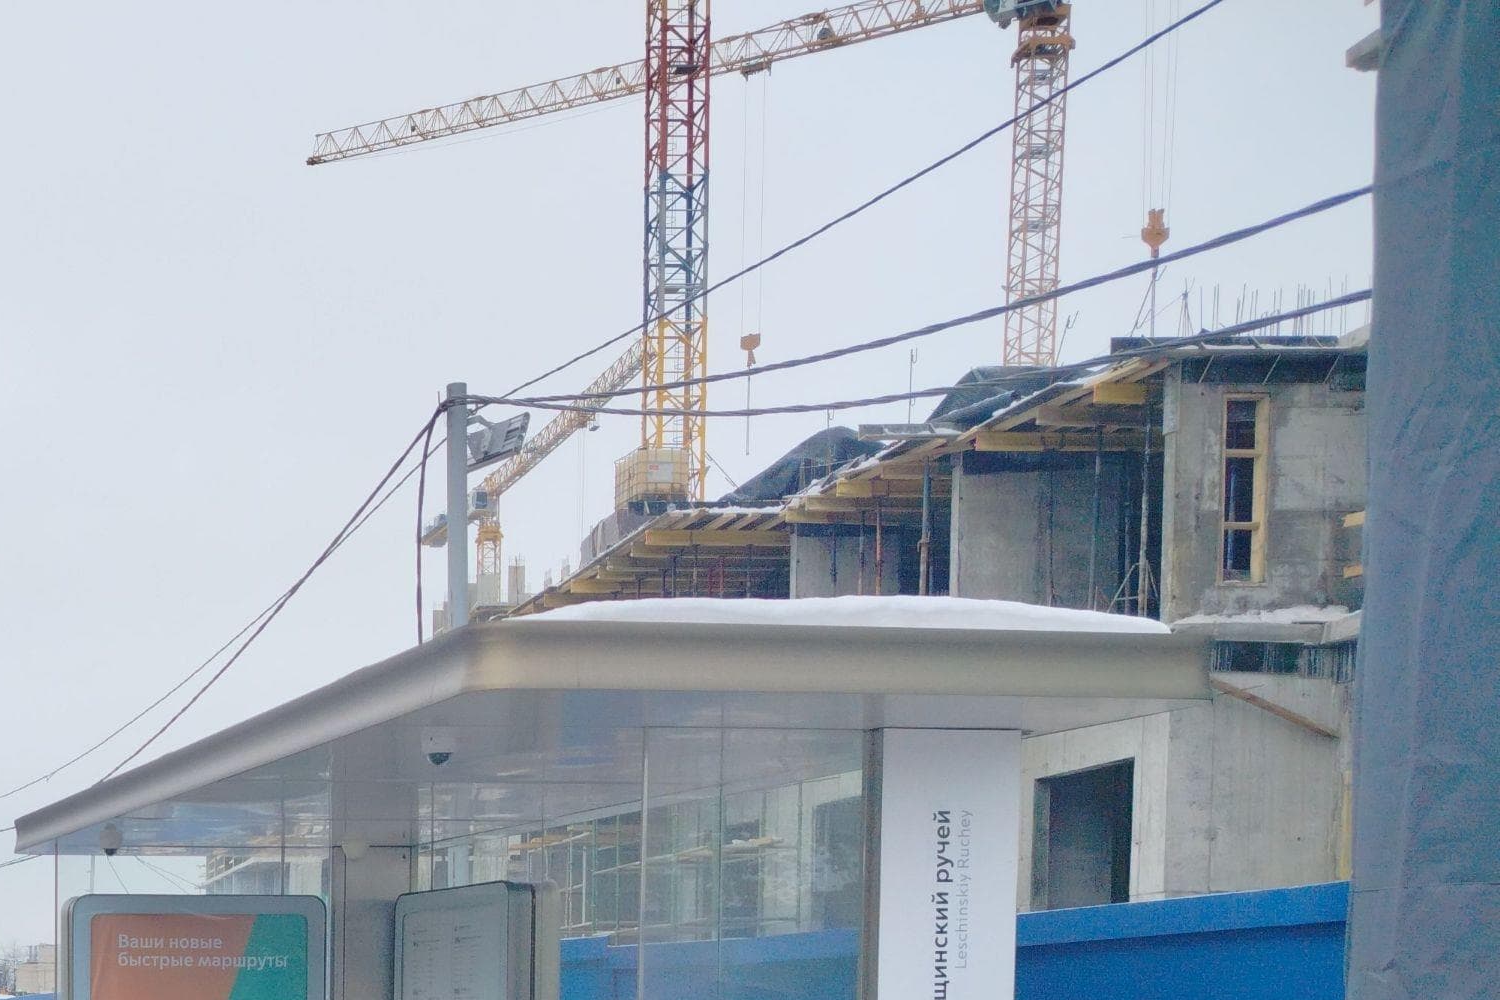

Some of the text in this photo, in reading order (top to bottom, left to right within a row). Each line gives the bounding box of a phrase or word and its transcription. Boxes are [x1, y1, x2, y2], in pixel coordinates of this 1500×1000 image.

[932, 810, 954, 884] ручей
[954, 809, 974, 970] Leschinskiy Ruchey
[117, 933, 223, 949] Ваши новые
[117, 952, 290, 971] быстрые маршруты
